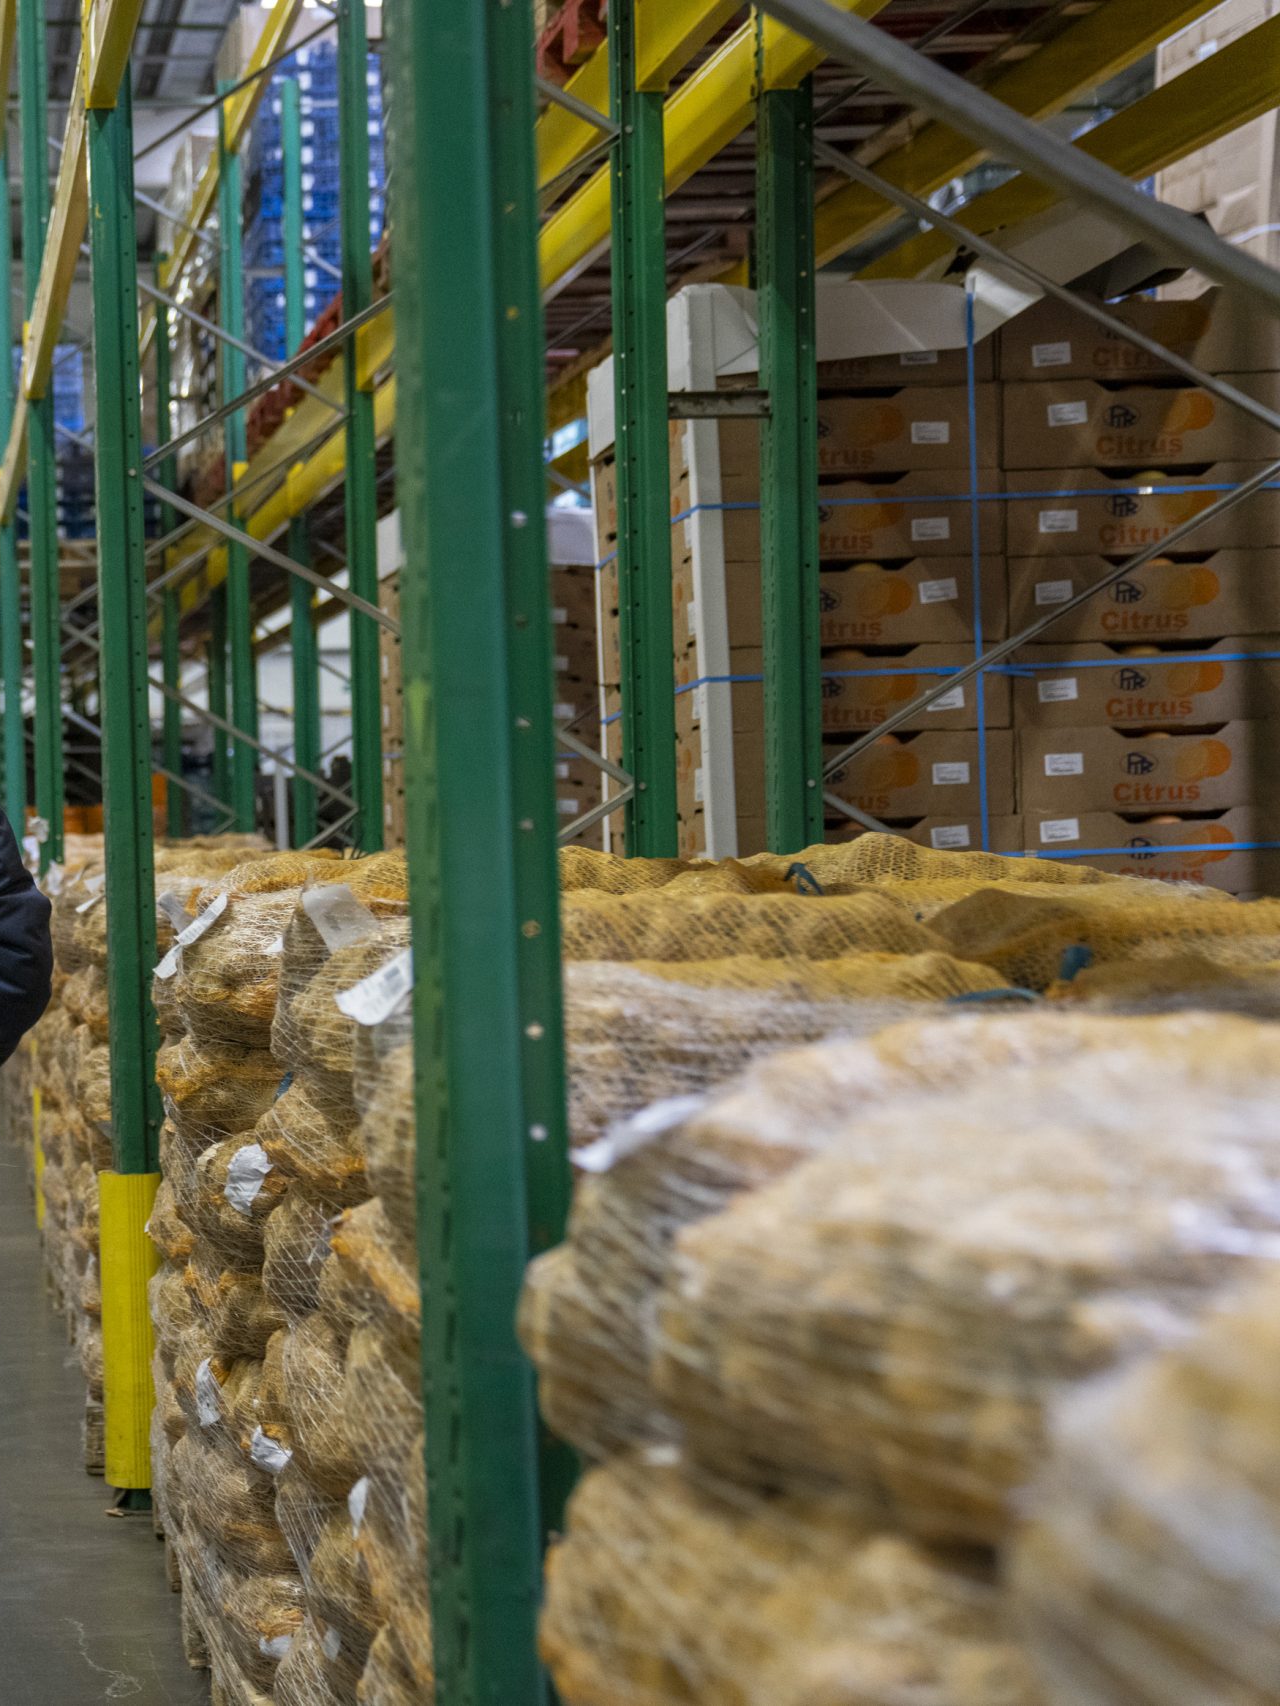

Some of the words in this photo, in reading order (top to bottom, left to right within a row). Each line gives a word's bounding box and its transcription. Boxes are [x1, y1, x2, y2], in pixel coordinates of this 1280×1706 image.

[1095, 436, 1184, 455] Citrus
[1100, 610, 1190, 633] Citrus
[822, 704, 888, 724] itrus
[1105, 697, 1194, 719] Citrus
[1113, 783, 1201, 802] Citrus
